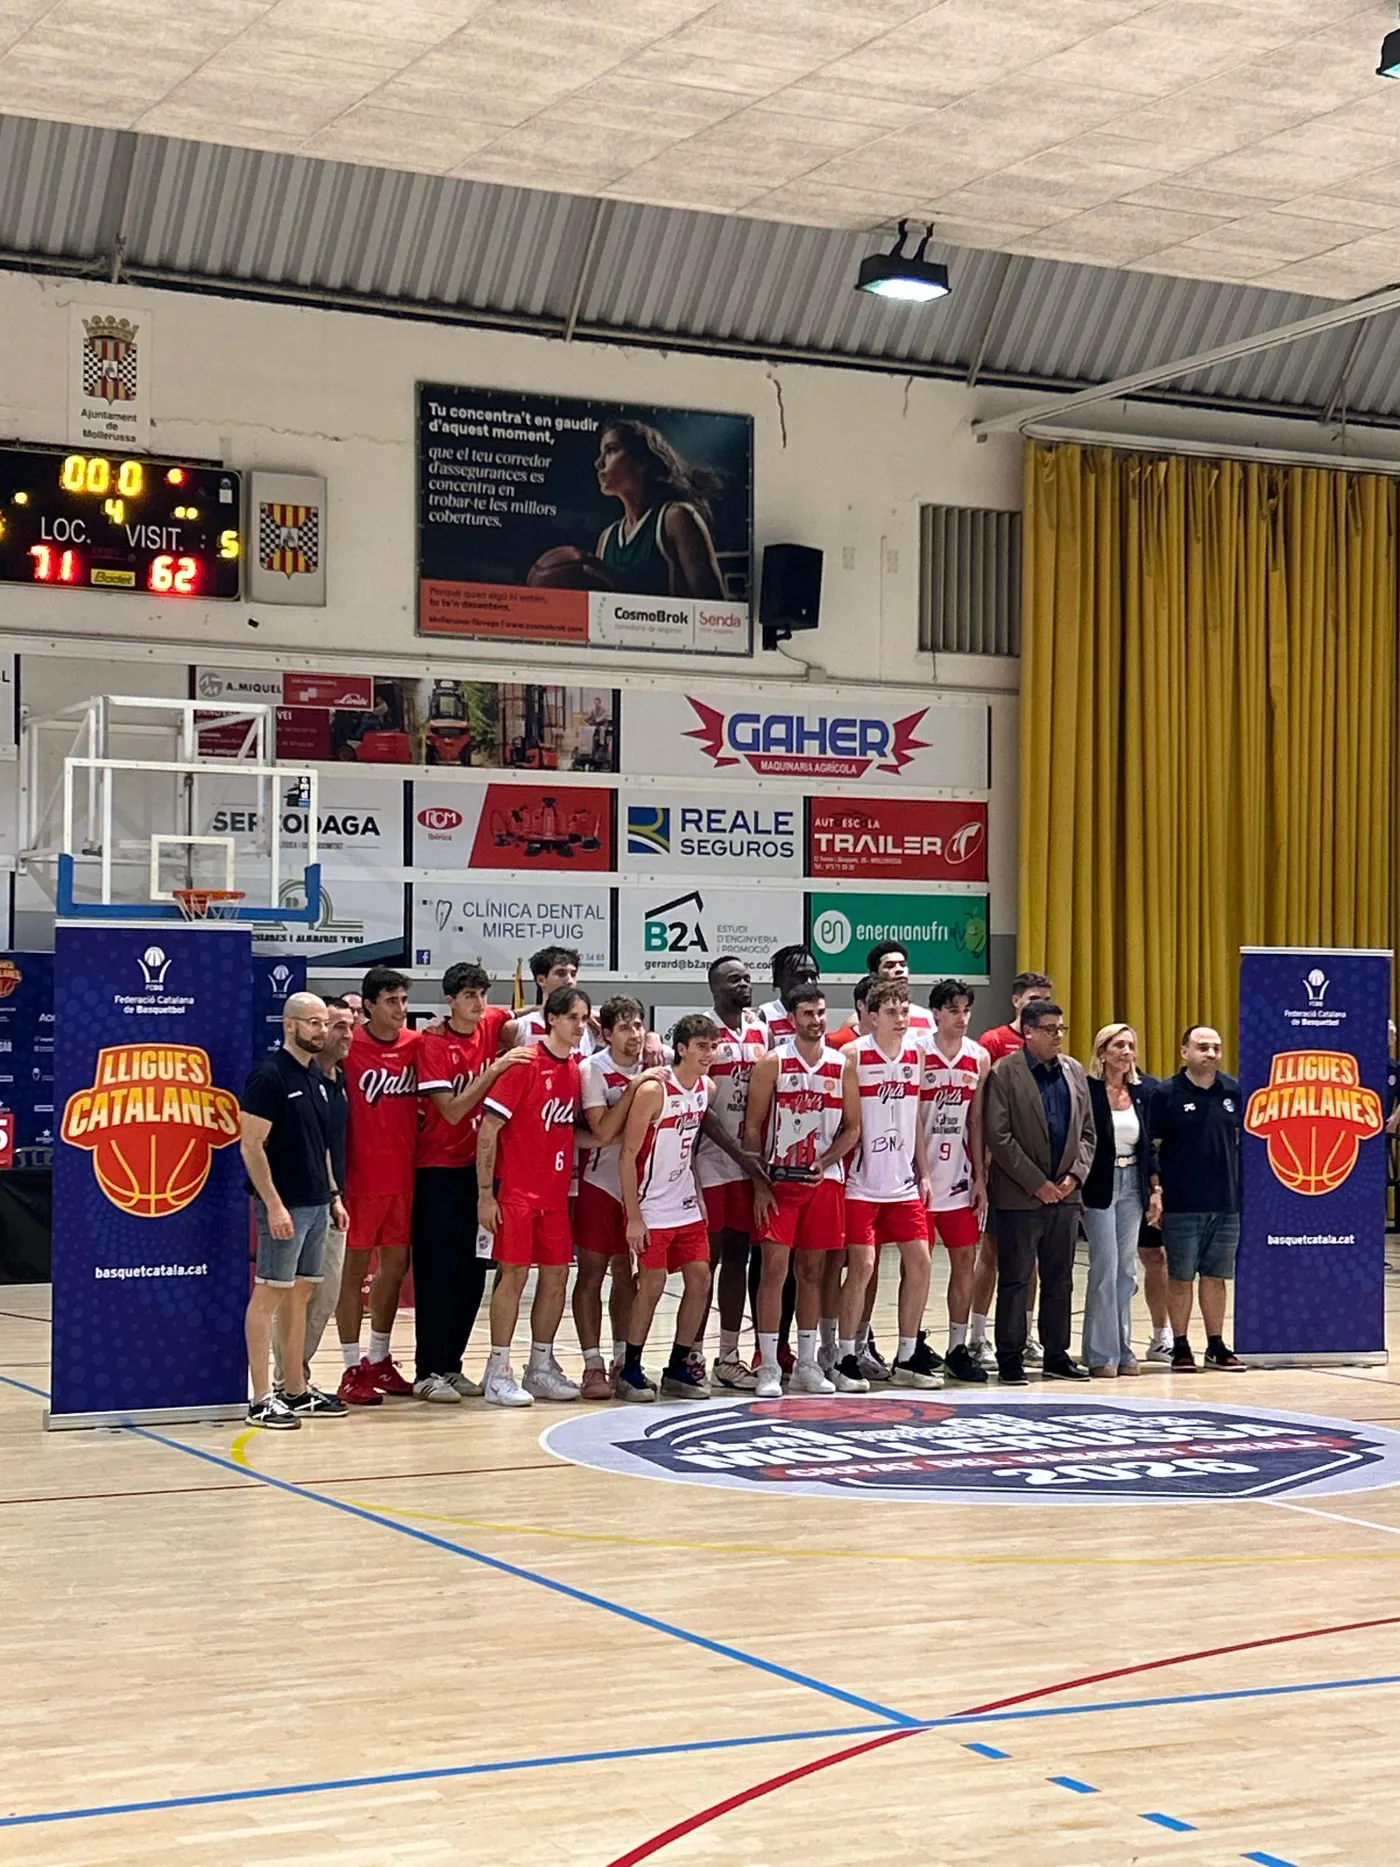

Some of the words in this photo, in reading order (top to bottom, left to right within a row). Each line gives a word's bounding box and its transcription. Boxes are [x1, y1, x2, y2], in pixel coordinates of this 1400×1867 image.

[81, 408, 137, 423] Ajuntament
[106, 422, 118, 431] de
[428, 402, 446, 417] Tu
[450, 406, 532, 426] concentra't
[534, 417, 552, 428] en
[555, 417, 599, 432] gaudir
[83, 429, 137, 443] Mollerussa
[428, 419, 489, 438] d'aquest
[492, 427, 556, 446] moment,
[428, 447, 454, 462] que
[456, 447, 469, 457] el
[471, 451, 493, 463] teu
[495, 454, 552, 469] corredor
[428, 461, 527, 482] d'assegurances
[529, 472, 545, 483] es
[428, 479, 496, 495] concentra
[498, 485, 515, 497] en
[428, 493, 487, 510] trobar-te
[489, 498, 508, 512] les
[510, 501, 557, 516] millors
[428, 510, 503, 528] cobertures.
[41, 516, 91, 544] LOC.
[126, 524, 184, 551] VISIT.
[29, 545, 75, 581] 71
[149, 555, 198, 592] 62
[614, 607, 688, 625] CosmoBrok
[699, 611, 742, 628] Senda
[728, 713, 889, 758] GAHER
[761, 760, 813, 772] MAQUINARIA
[814, 761, 857, 774] AGRÍCOLA
[212, 811, 381, 836] SERODAGA
[680, 807, 794, 836] REALE
[680, 839, 795, 858] SEGUROS
[814, 833, 942, 855] TRAILER
[462, 898, 532, 919] CLÍNICA
[537, 903, 605, 920] DENTAL
[482, 922, 584, 940] MIRET-PUIG
[644, 921, 708, 952] B2A
[717, 925, 748, 933] ESTUDI
[722, 944, 770, 954] PROMOCIÓ
[114, 995, 155, 1004] Federació
[157, 995, 195, 1004] Catalana
[123, 1005, 134, 1014] de
[136, 1005, 186, 1015] Basquetbol
[102, 1050, 205, 1085] LLIGUES
[1274, 1055, 1354, 1086] LLIGUES
[68, 1087, 237, 1137] CATALANES
[1250, 1085, 1379, 1129] CATALANES
[680, 1137, 692, 1159] 5
[939, 1142, 951, 1161] 9
[555, 1151, 564, 1171] 6
[1267, 1234, 1355, 1247] basquetcatala.cat
[95, 1263, 208, 1279] basquetcatala.cat
[673, 1423, 1317, 1469] MOLLERUSSA
[785, 1461, 923, 1477] CIUTAT
[924, 1458, 1013, 1467] DEL
[992, 1458, 1260, 1485] 2026
